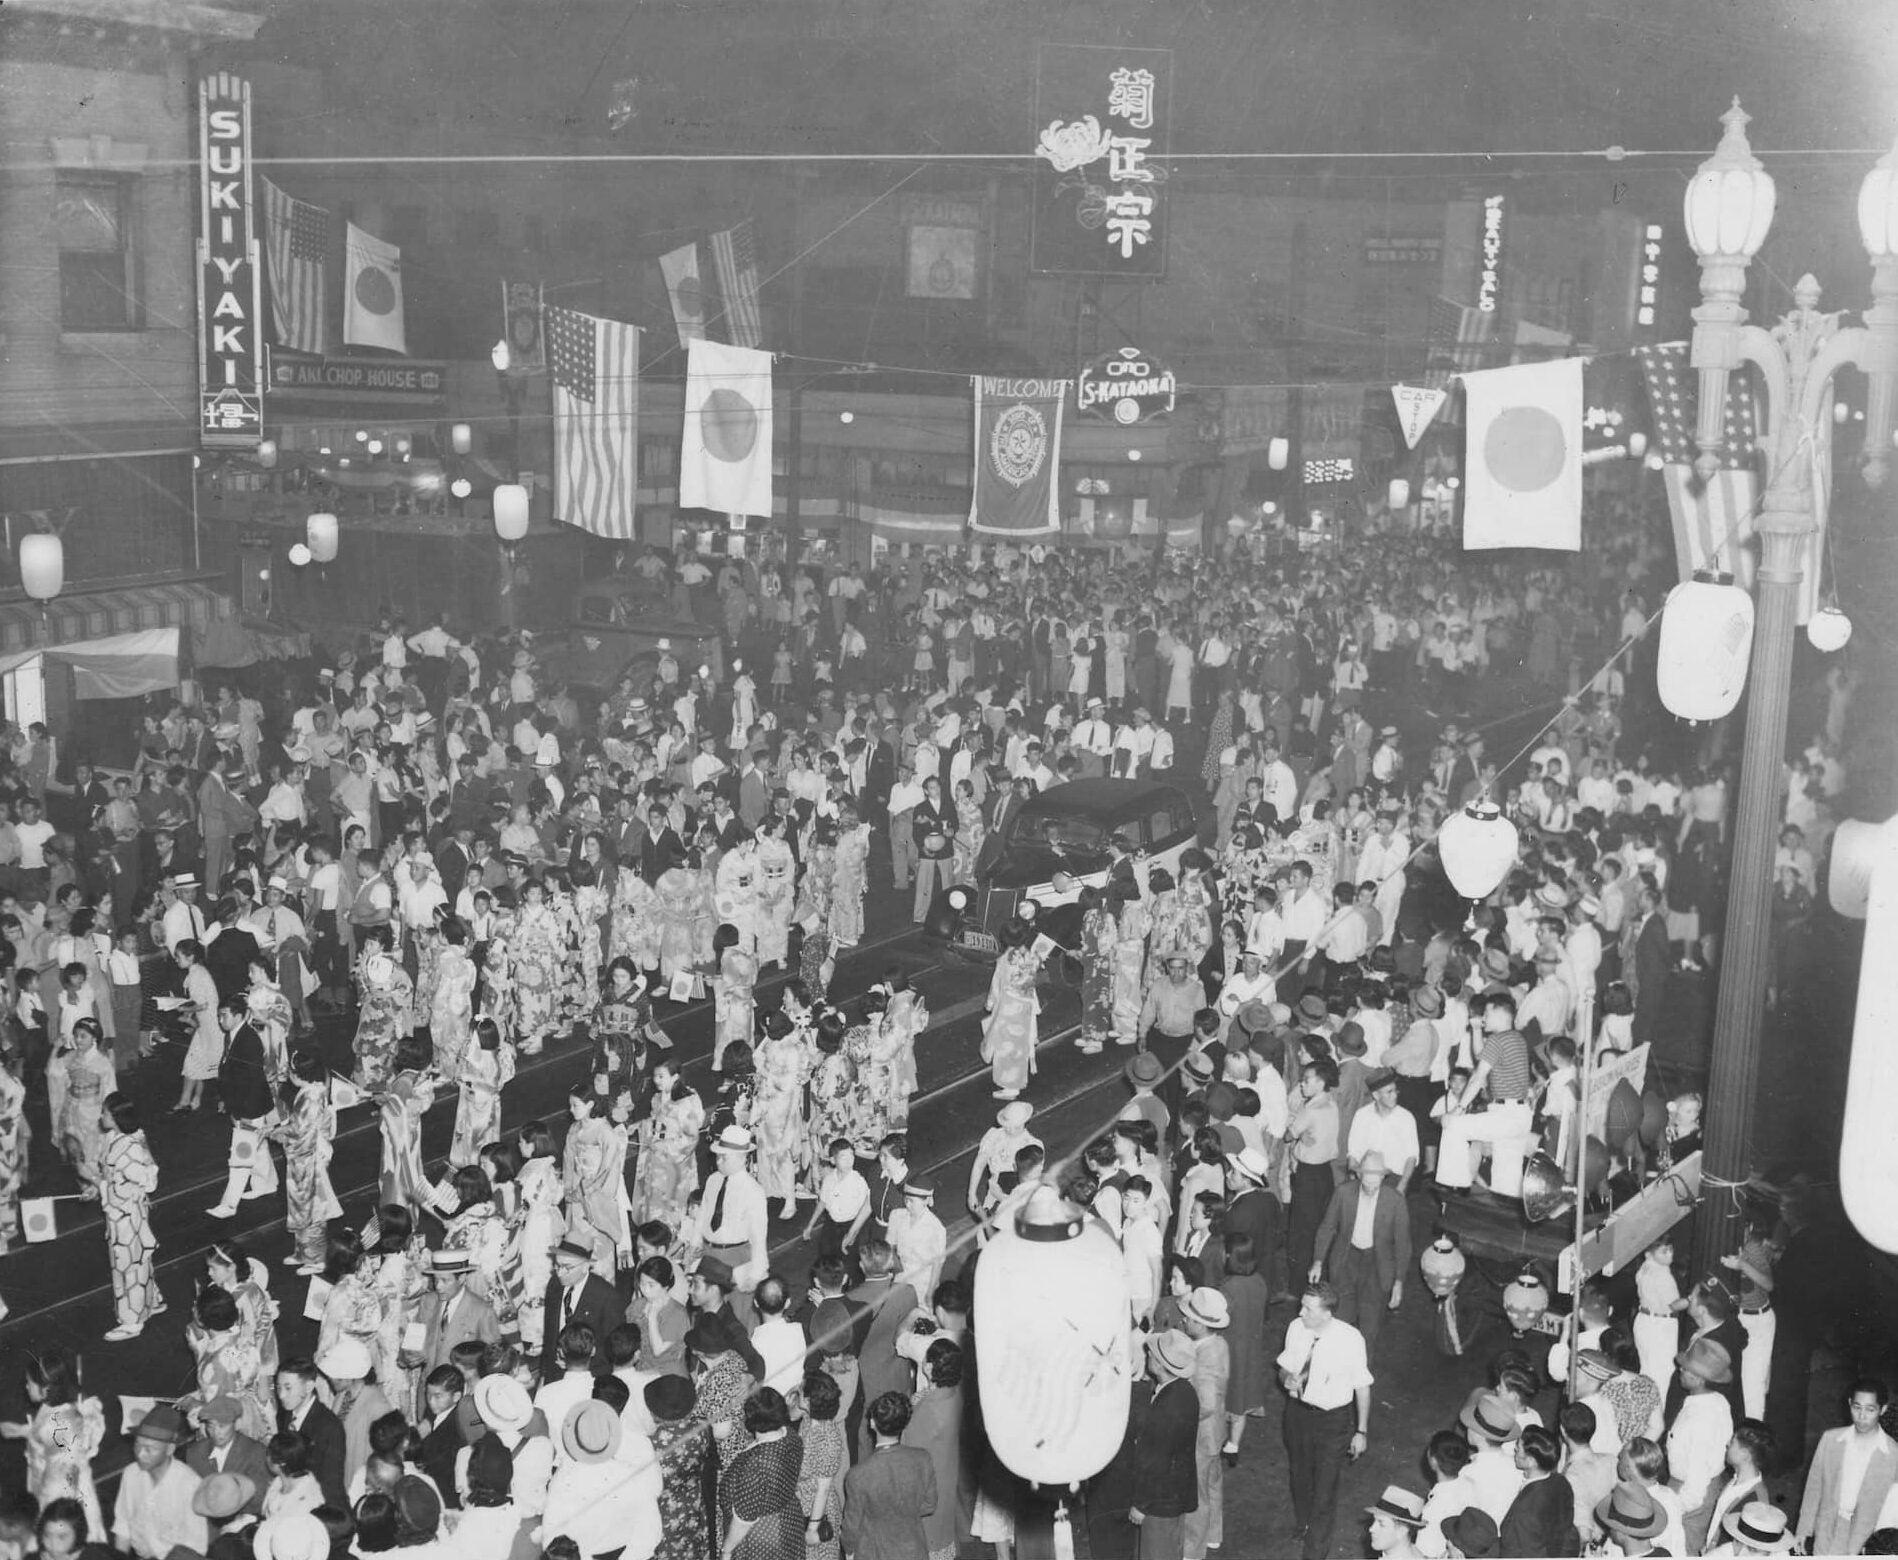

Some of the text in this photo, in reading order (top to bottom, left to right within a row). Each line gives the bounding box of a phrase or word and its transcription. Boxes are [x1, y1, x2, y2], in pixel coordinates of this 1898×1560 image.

[1107, 67, 1155, 258] 菊正宗
[210, 110, 246, 385] SUKIYAKI
[1479, 270, 1496, 312] SALO
[326, 366, 363, 387] CHOP
[367, 369, 417, 389] HOUSE
[984, 376, 1064, 398] WELCOME
